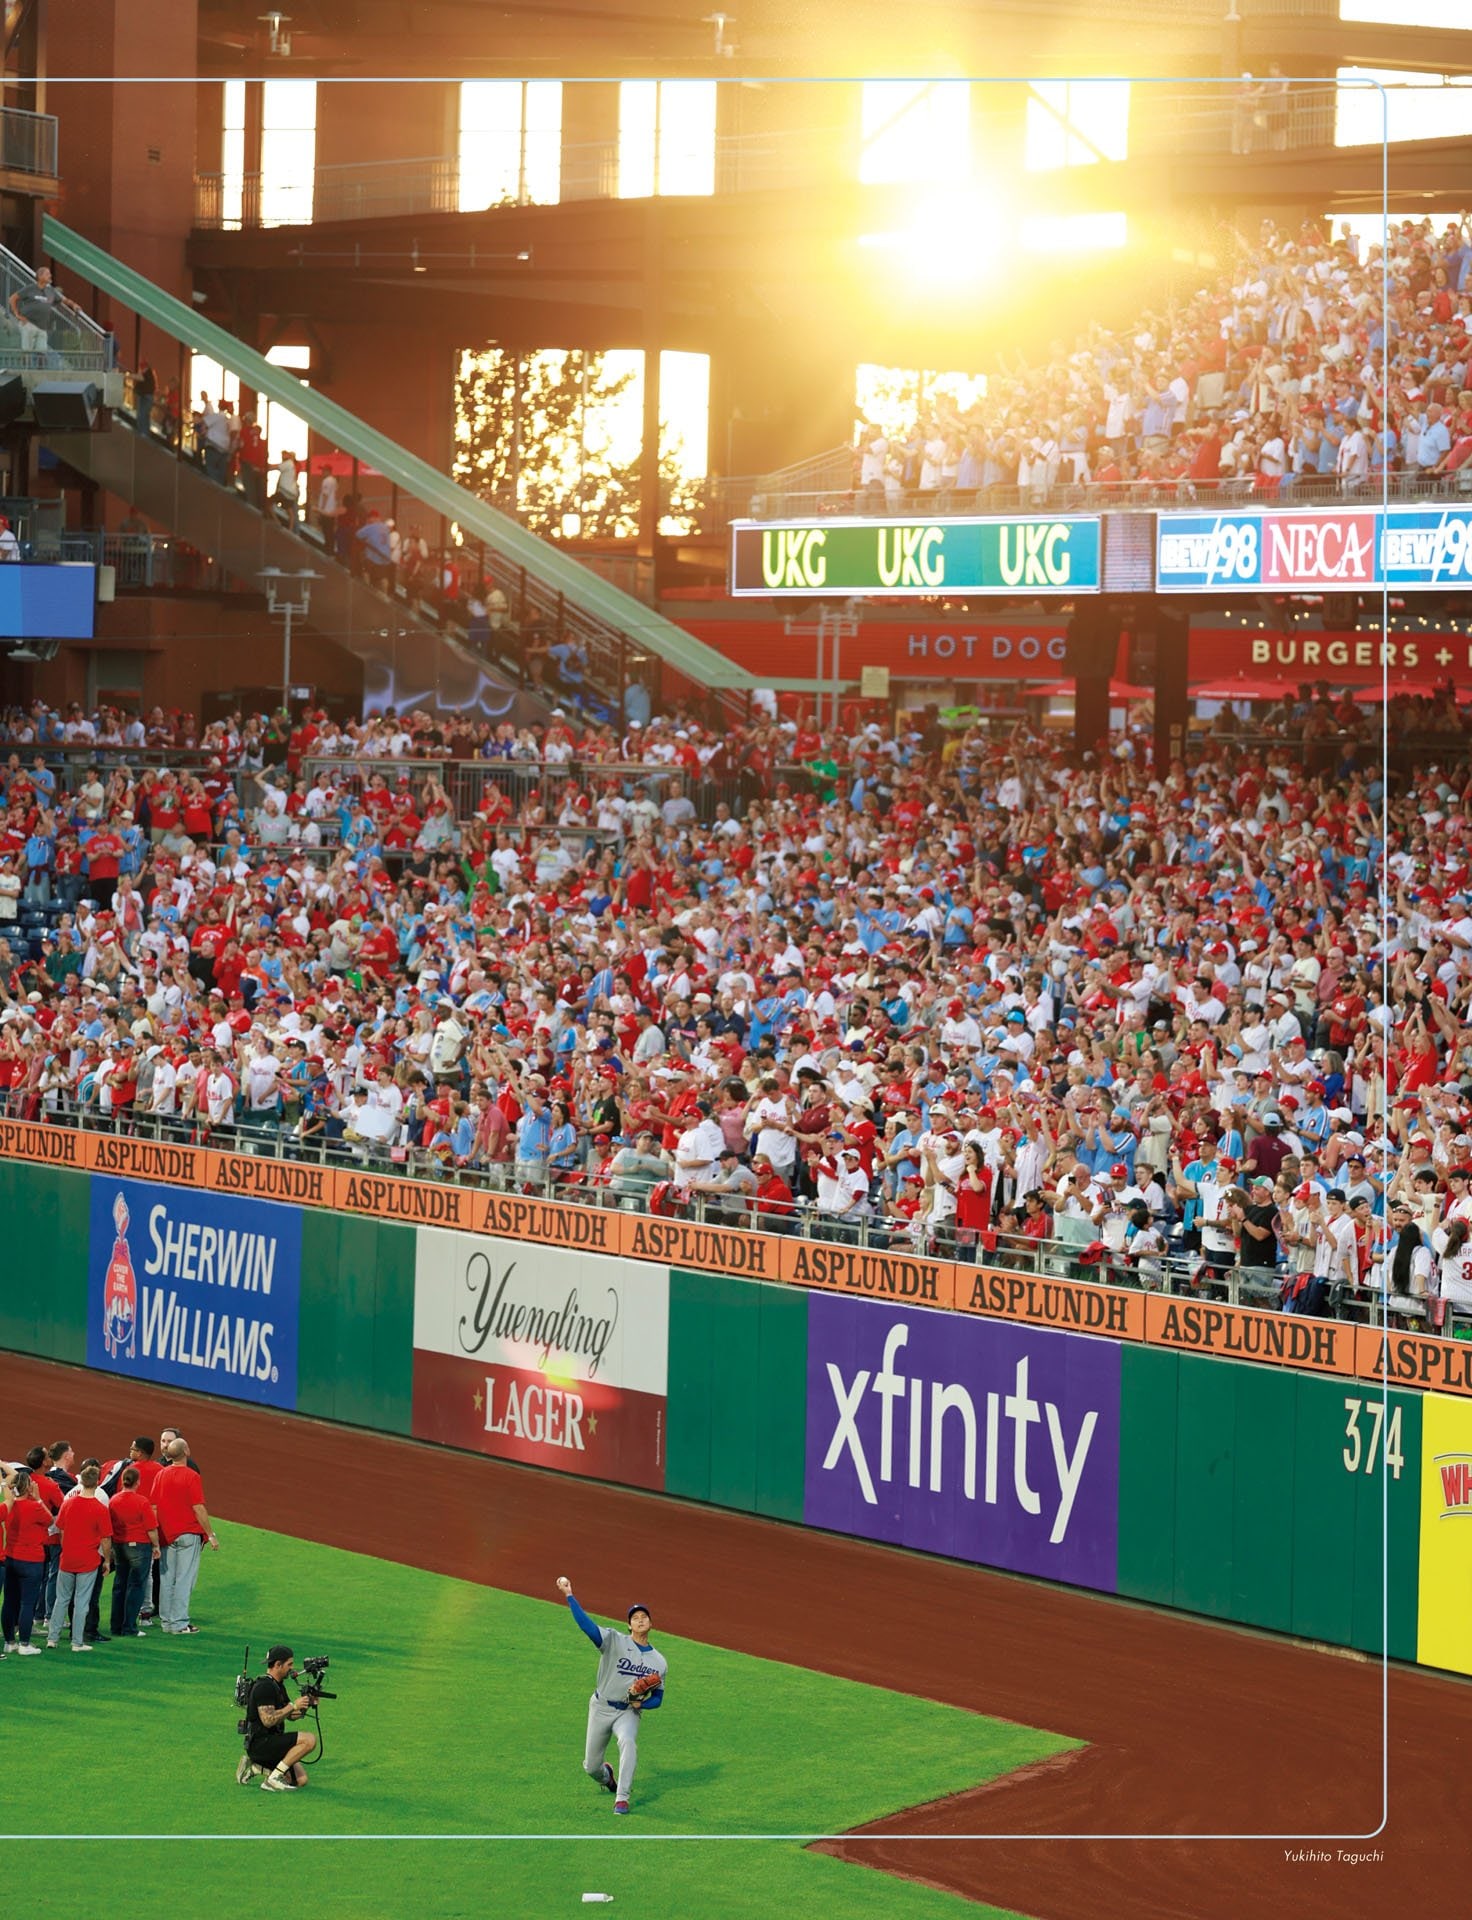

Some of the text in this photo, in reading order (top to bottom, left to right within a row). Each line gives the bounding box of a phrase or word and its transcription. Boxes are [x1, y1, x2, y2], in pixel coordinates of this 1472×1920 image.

[762, 529, 827, 587] UKG
[877, 527, 945, 586] UKG
[999, 524, 1070, 586] UKG
[1269, 522, 1373, 577] NECA
[908, 635, 978, 657] HOT
[1252, 639, 1418, 667] BURGERS
[95, 1139, 196, 1181] ASPLUNDH
[216, 1158, 324, 1201] ASPLUNDH
[345, 1177, 461, 1223] ASPLUNDH
[483, 1199, 607, 1246] ASPLUNDH
[144, 1204, 277, 1295] SHERWIN
[632, 1222, 766, 1273] ASPLUNDH
[793, 1247, 939, 1301] ASPLUNDH
[458, 1252, 619, 1379] Yuengling
[969, 1274, 1128, 1333] ASPLUNDH
[1161, 1305, 1336, 1367] ASPLUNDH
[484, 1377, 586, 1451] LAGER
[823, 1323, 1099, 1544] xfinity
[1343, 1398, 1405, 1480] 374
